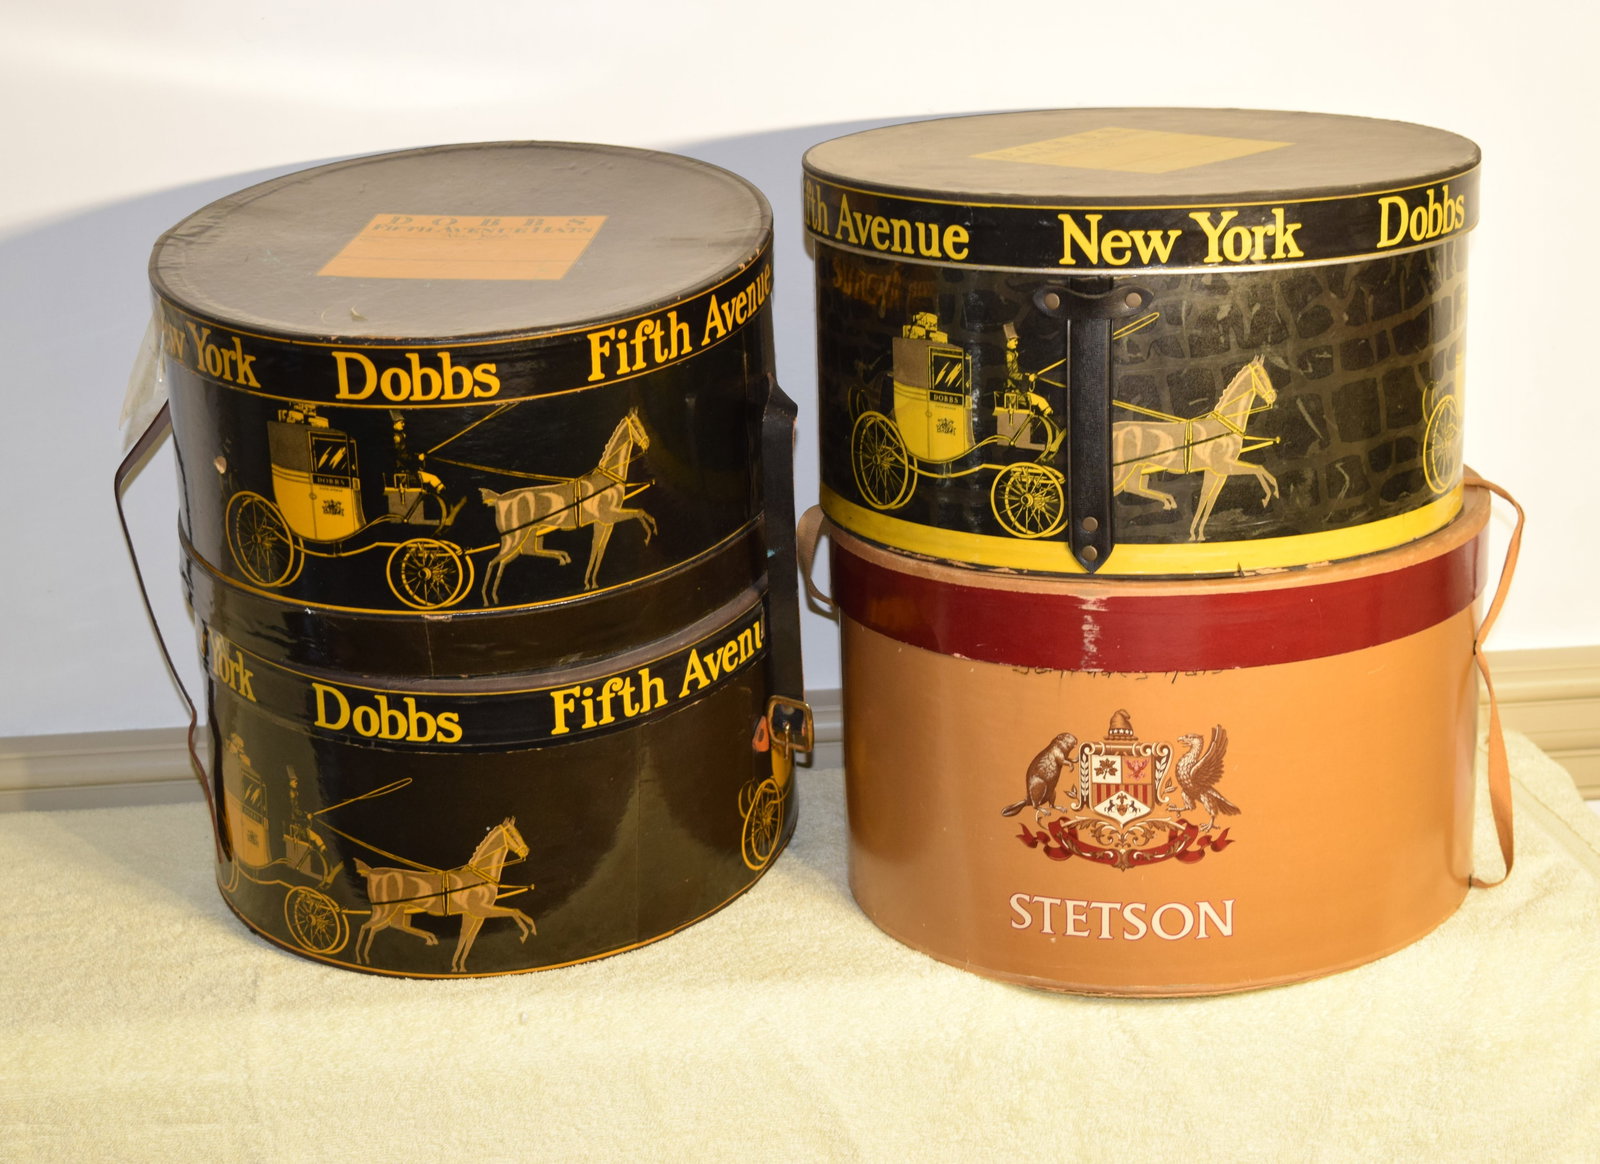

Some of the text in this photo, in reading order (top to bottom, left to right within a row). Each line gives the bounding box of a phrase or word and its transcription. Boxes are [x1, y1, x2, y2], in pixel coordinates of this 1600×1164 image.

[835, 193, 970, 260] Avenue
[1057, 213, 1183, 266] New
[1188, 207, 1304, 263] York
[1376, 184, 1465, 248] Dobbs
[186, 320, 261, 388] York
[331, 351, 501, 402] Dobbs
[587, 310, 693, 382] Fifth
[701, 263, 771, 347] Avenue
[207, 625, 257, 702] York
[312, 682, 463, 743] Dobbs
[550, 667, 668, 735] Fifth
[1009, 892, 1236, 941] STETSON
